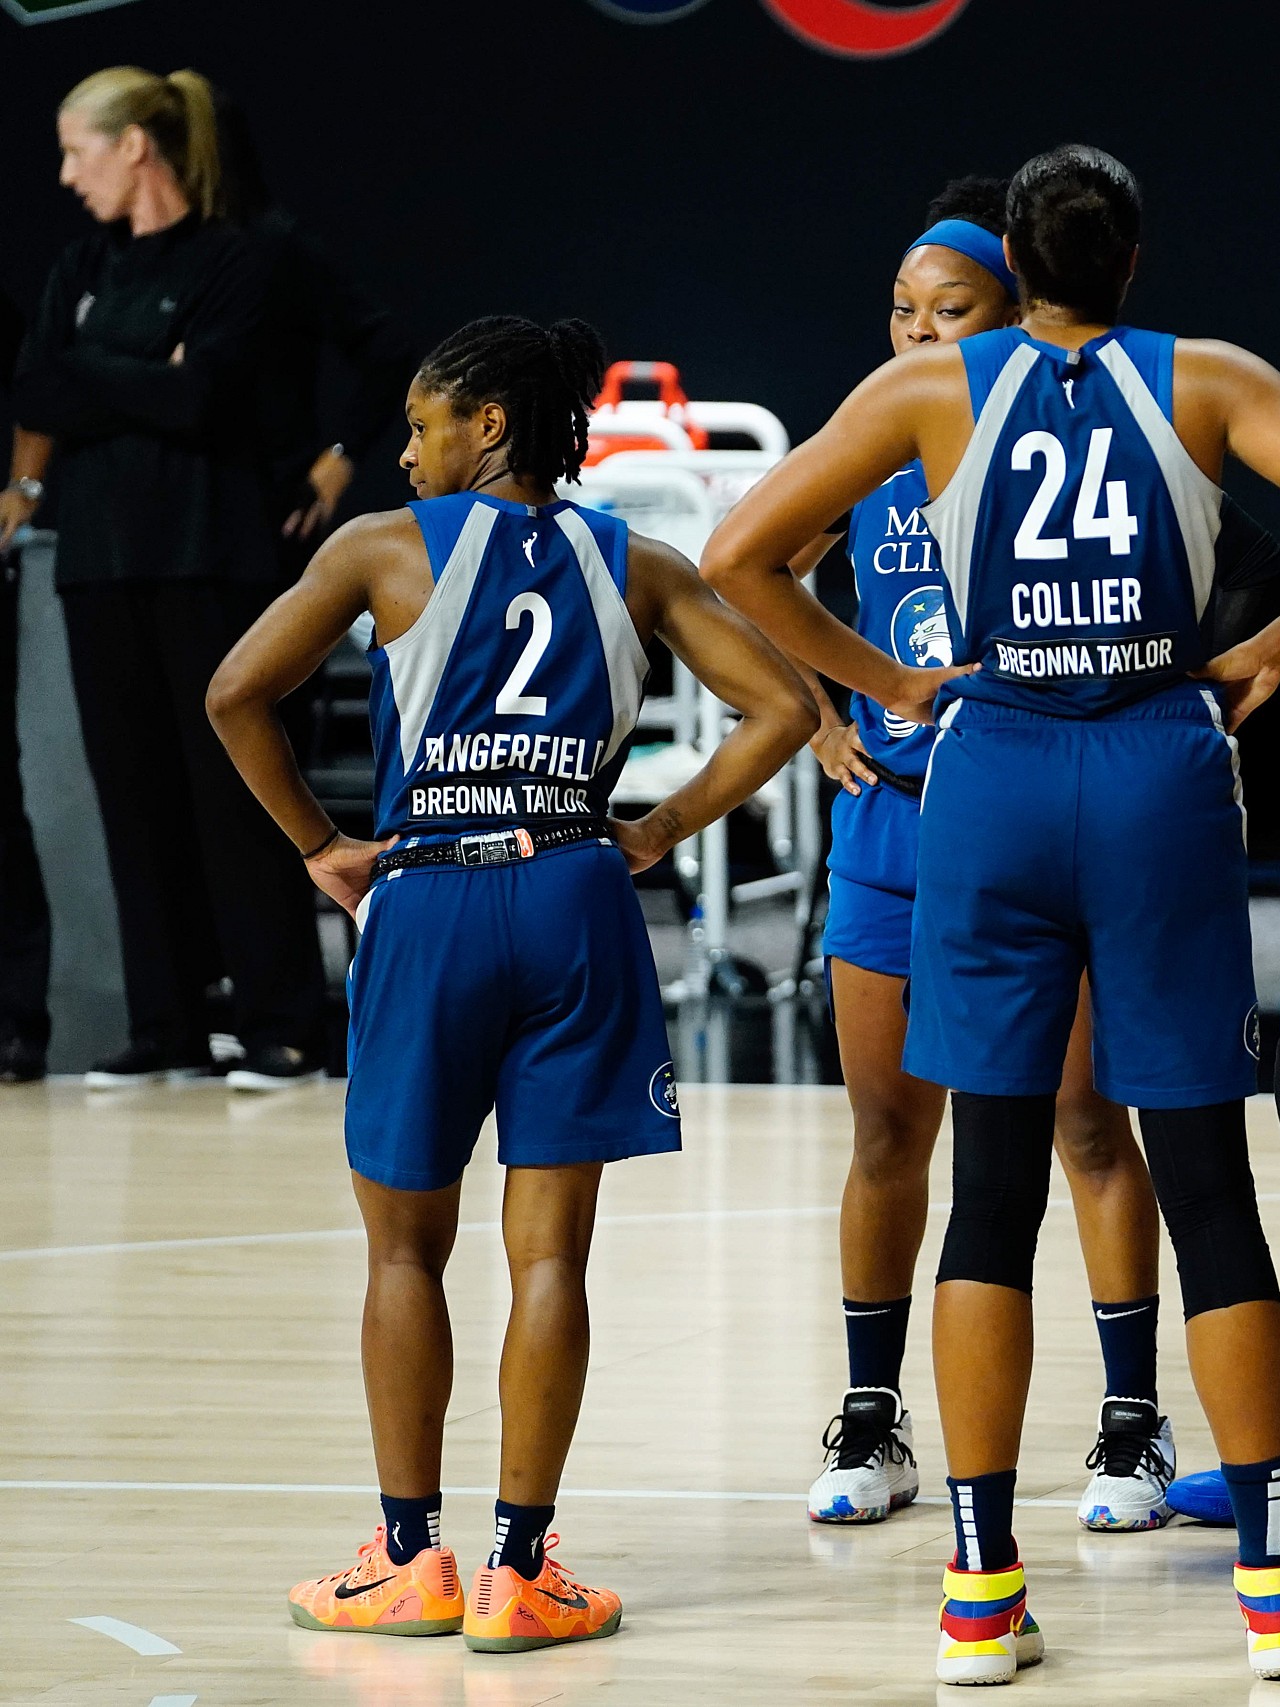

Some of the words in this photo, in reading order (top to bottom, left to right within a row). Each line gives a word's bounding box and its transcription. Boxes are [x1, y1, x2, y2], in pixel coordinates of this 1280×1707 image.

[1011, 427, 1139, 560] 24
[873, 541, 940, 575] CLI
[1012, 578, 1142, 630] COLLIER
[495, 591, 553, 717] 2
[998, 642, 1094, 678] BREONNA
[1097, 637, 1173, 675] TAYLOR
[412, 785, 518, 816] BREONNA
[522, 785, 592, 814] TAYLOR
